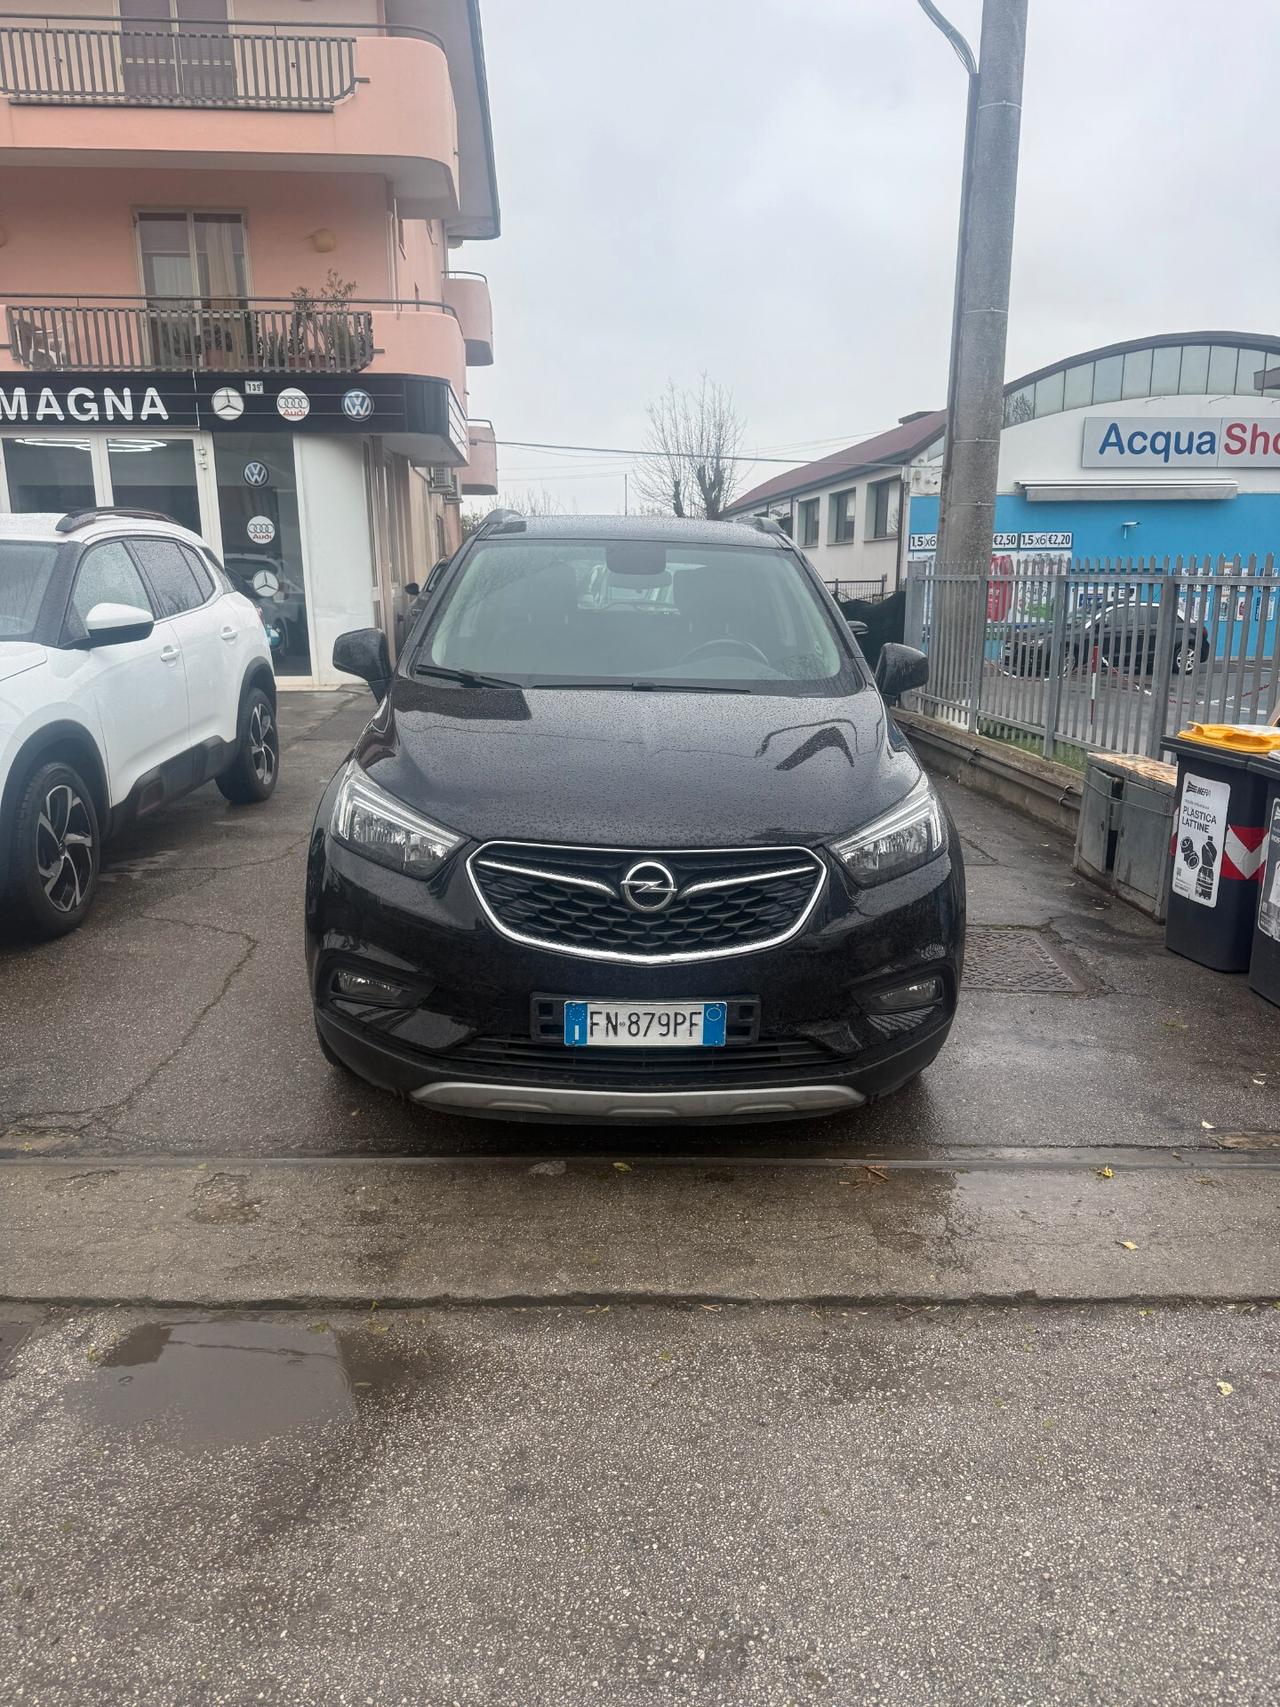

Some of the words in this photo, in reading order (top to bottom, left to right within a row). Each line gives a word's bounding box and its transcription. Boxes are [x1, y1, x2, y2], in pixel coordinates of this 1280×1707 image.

[0, 387, 169, 421] MAGNA
[1098, 422, 1216, 463] Acqua
[911, 536, 924, 548] 1,5
[993, 534, 1016, 547] €2,50
[1022, 534, 1034, 546] 1,5
[1048, 534, 1070, 545] €2,20
[1183, 805, 1217, 825] PLASTICA
[1181, 816, 1210, 833] LATTINE
